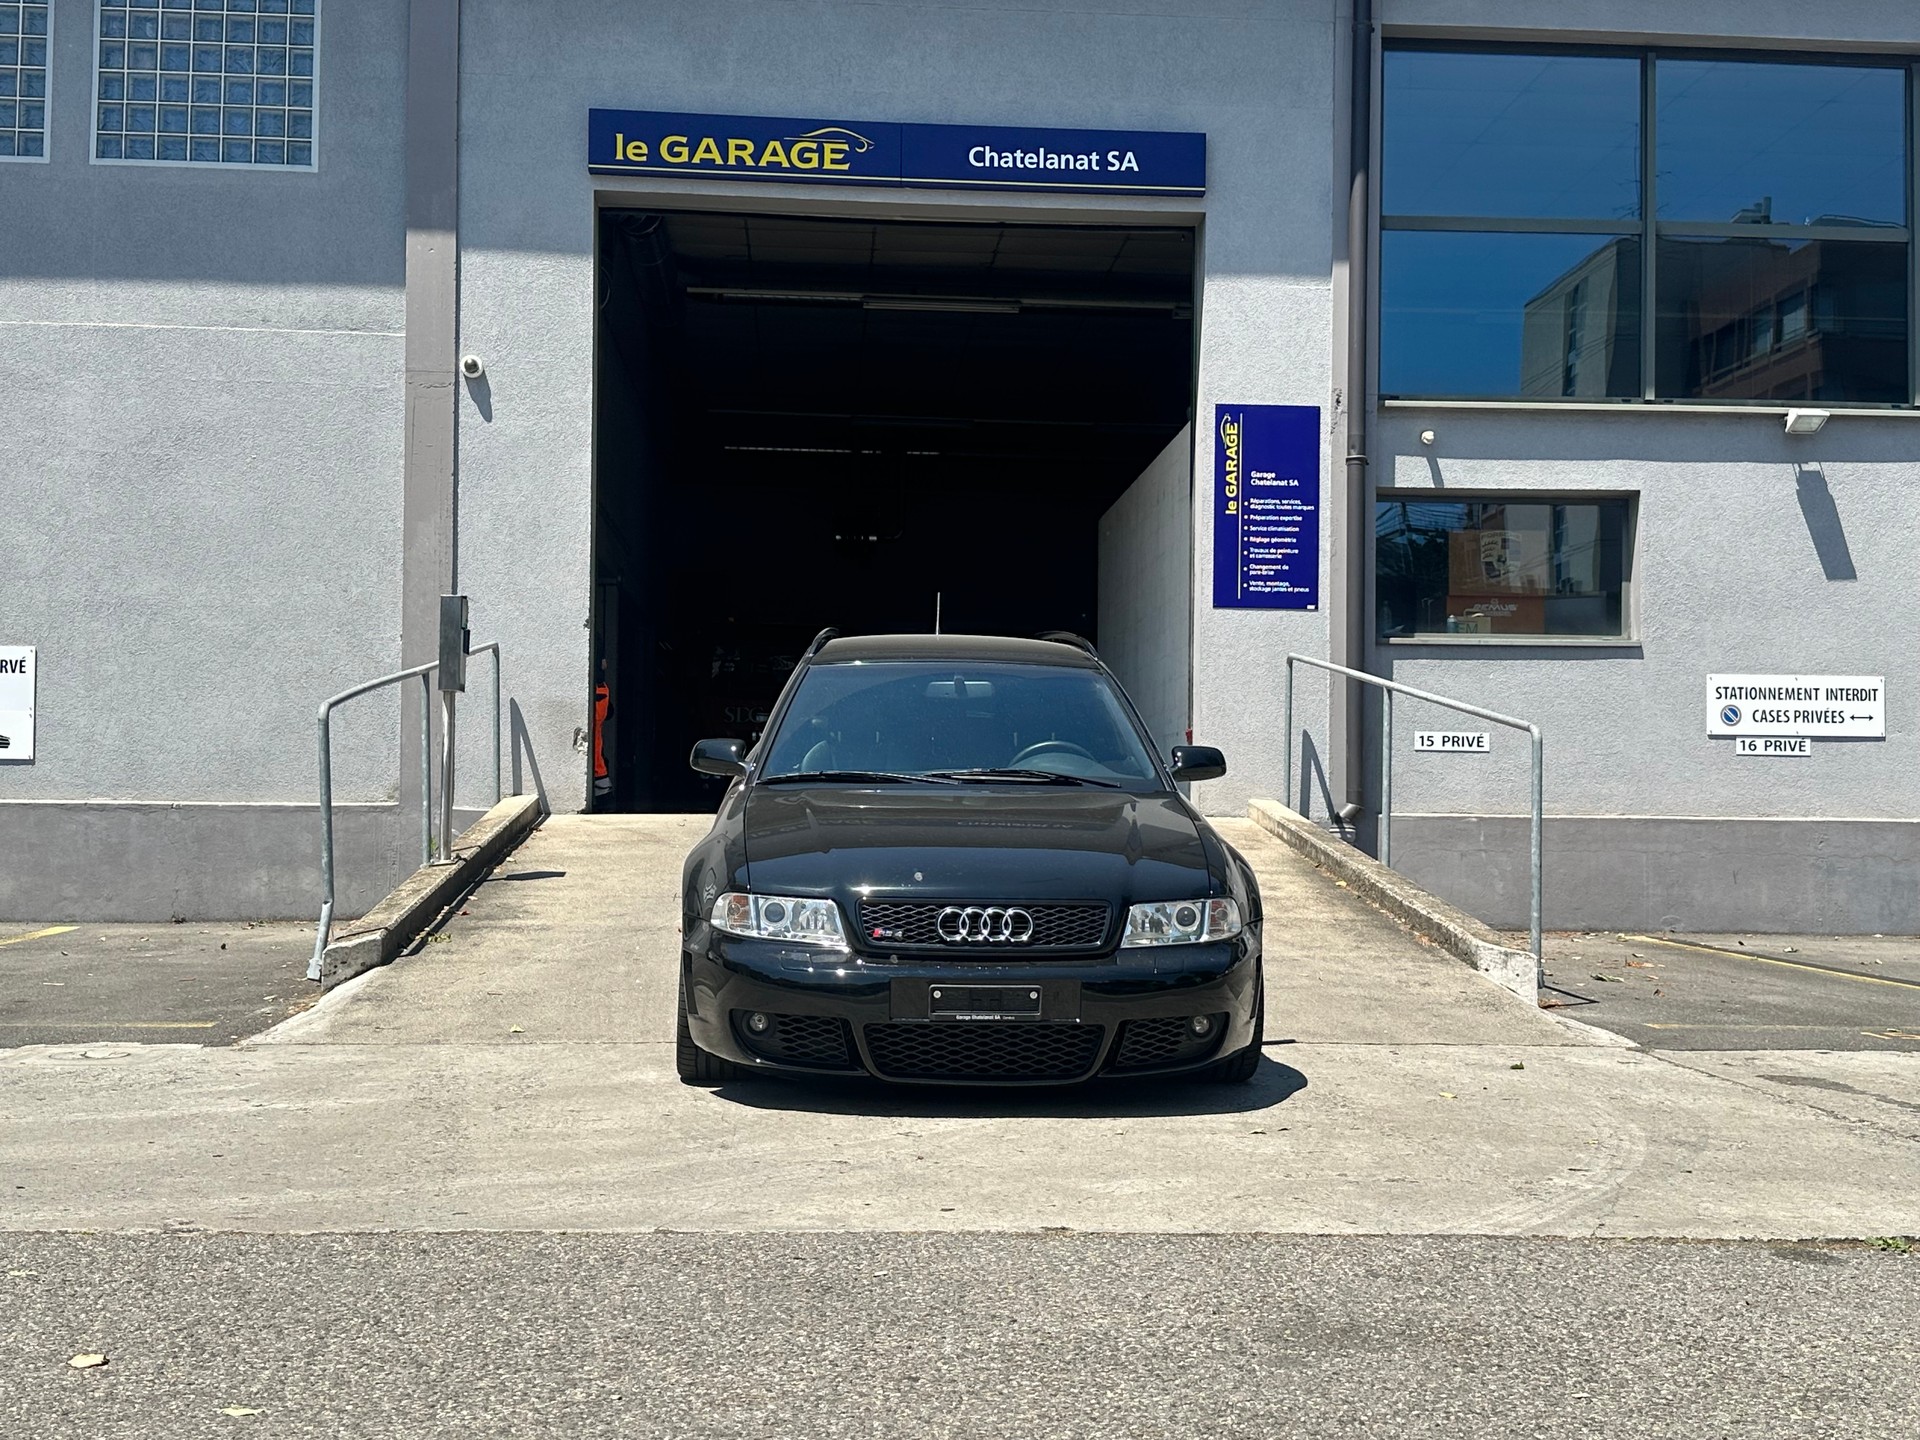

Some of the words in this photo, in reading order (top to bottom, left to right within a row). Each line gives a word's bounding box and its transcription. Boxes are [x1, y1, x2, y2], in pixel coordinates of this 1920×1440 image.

[615, 133, 648, 162] le
[659, 135, 850, 170] GARAGE
[968, 145, 1100, 171] Chatelanat
[1107, 150, 1140, 172] SA
[1225, 422, 1238, 498] GARAGE
[1250, 471, 1276, 479] Garage
[1225, 500, 1237, 515] le
[1715, 686, 1820, 701] STATIONNEMENT
[1826, 688, 1878, 702] INTERDIT
[1752, 709, 1790, 723] CASES
[1794, 707, 1845, 724] PRIVÉES
[1419, 735, 1434, 747] 15
[1442, 733, 1484, 748] PRIVÉ
[1740, 740, 1757, 752] 16
[1764, 737, 1807, 752] PRIVÉ
